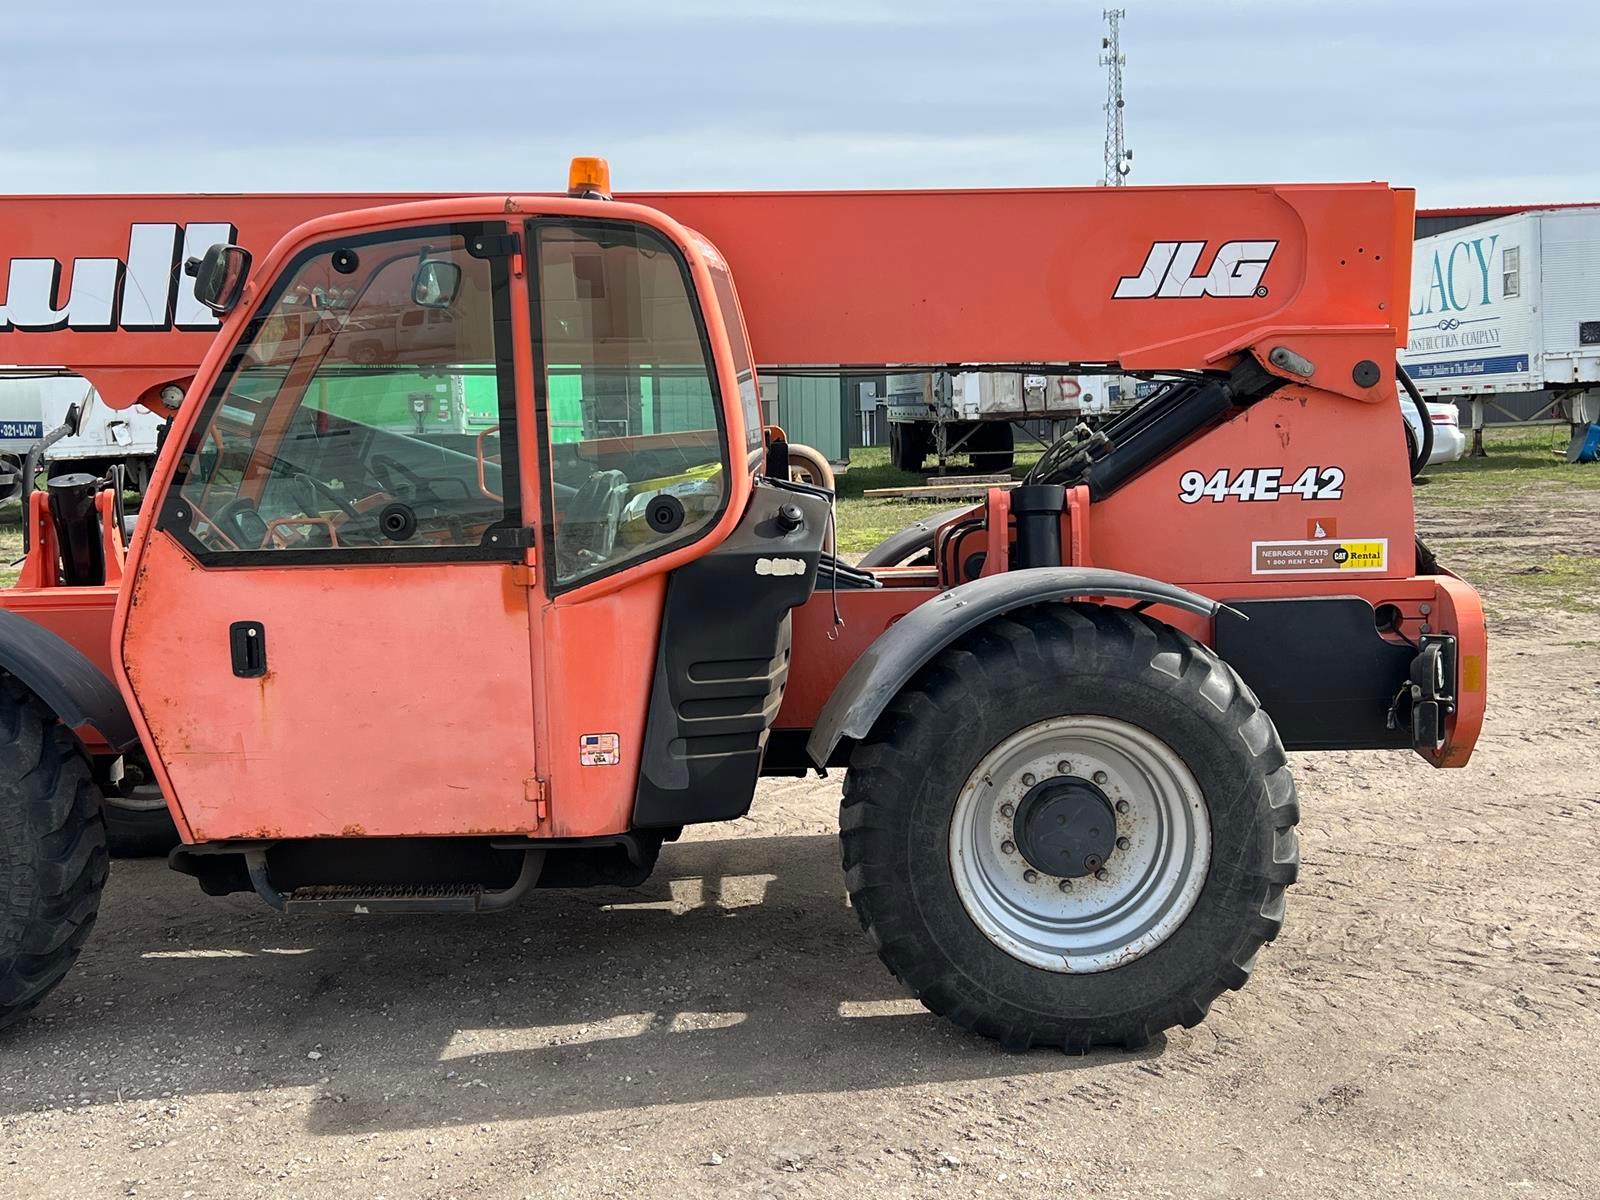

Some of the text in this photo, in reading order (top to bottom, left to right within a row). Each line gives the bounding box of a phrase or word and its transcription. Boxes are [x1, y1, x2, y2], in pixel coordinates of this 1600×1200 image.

[0, 222, 238, 332] ull
[1404, 327, 1500, 352] ONSTRUCTION COMPANY
[1178, 466, 1346, 504] 944E-42
[1334, 552, 1380, 560] CAT Rental
